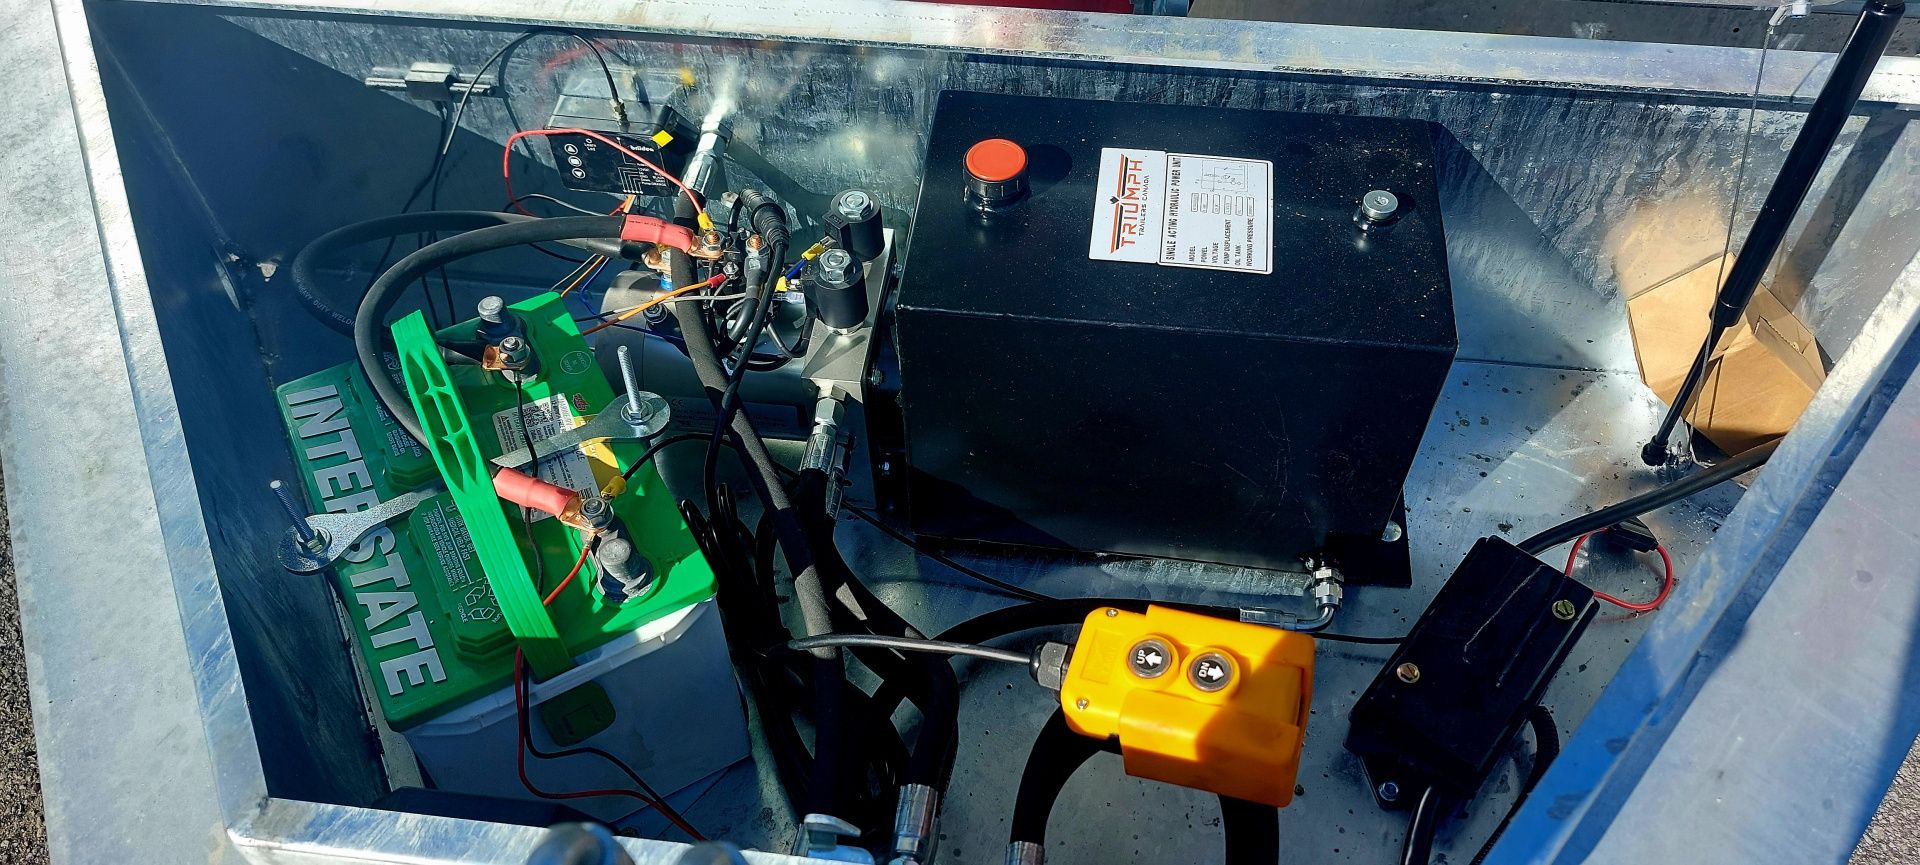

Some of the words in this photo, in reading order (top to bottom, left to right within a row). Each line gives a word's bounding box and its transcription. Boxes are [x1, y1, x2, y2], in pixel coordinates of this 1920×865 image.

[1172, 157, 1181, 167] UNIT
[1171, 169, 1181, 186] POWER
[1121, 159, 1143, 247] TRIUMPH
[1168, 188, 1180, 216] HYDRAULIC
[1139, 204, 1147, 236] TRAILERS
[1167, 218, 1178, 238] ACTING
[1166, 241, 1176, 260] SINGLE
[313, 299, 330, 313] DUTY
[332, 311, 356, 327] WELDI
[1136, 649, 1146, 664] UP
[1199, 662, 1210, 677] DN
